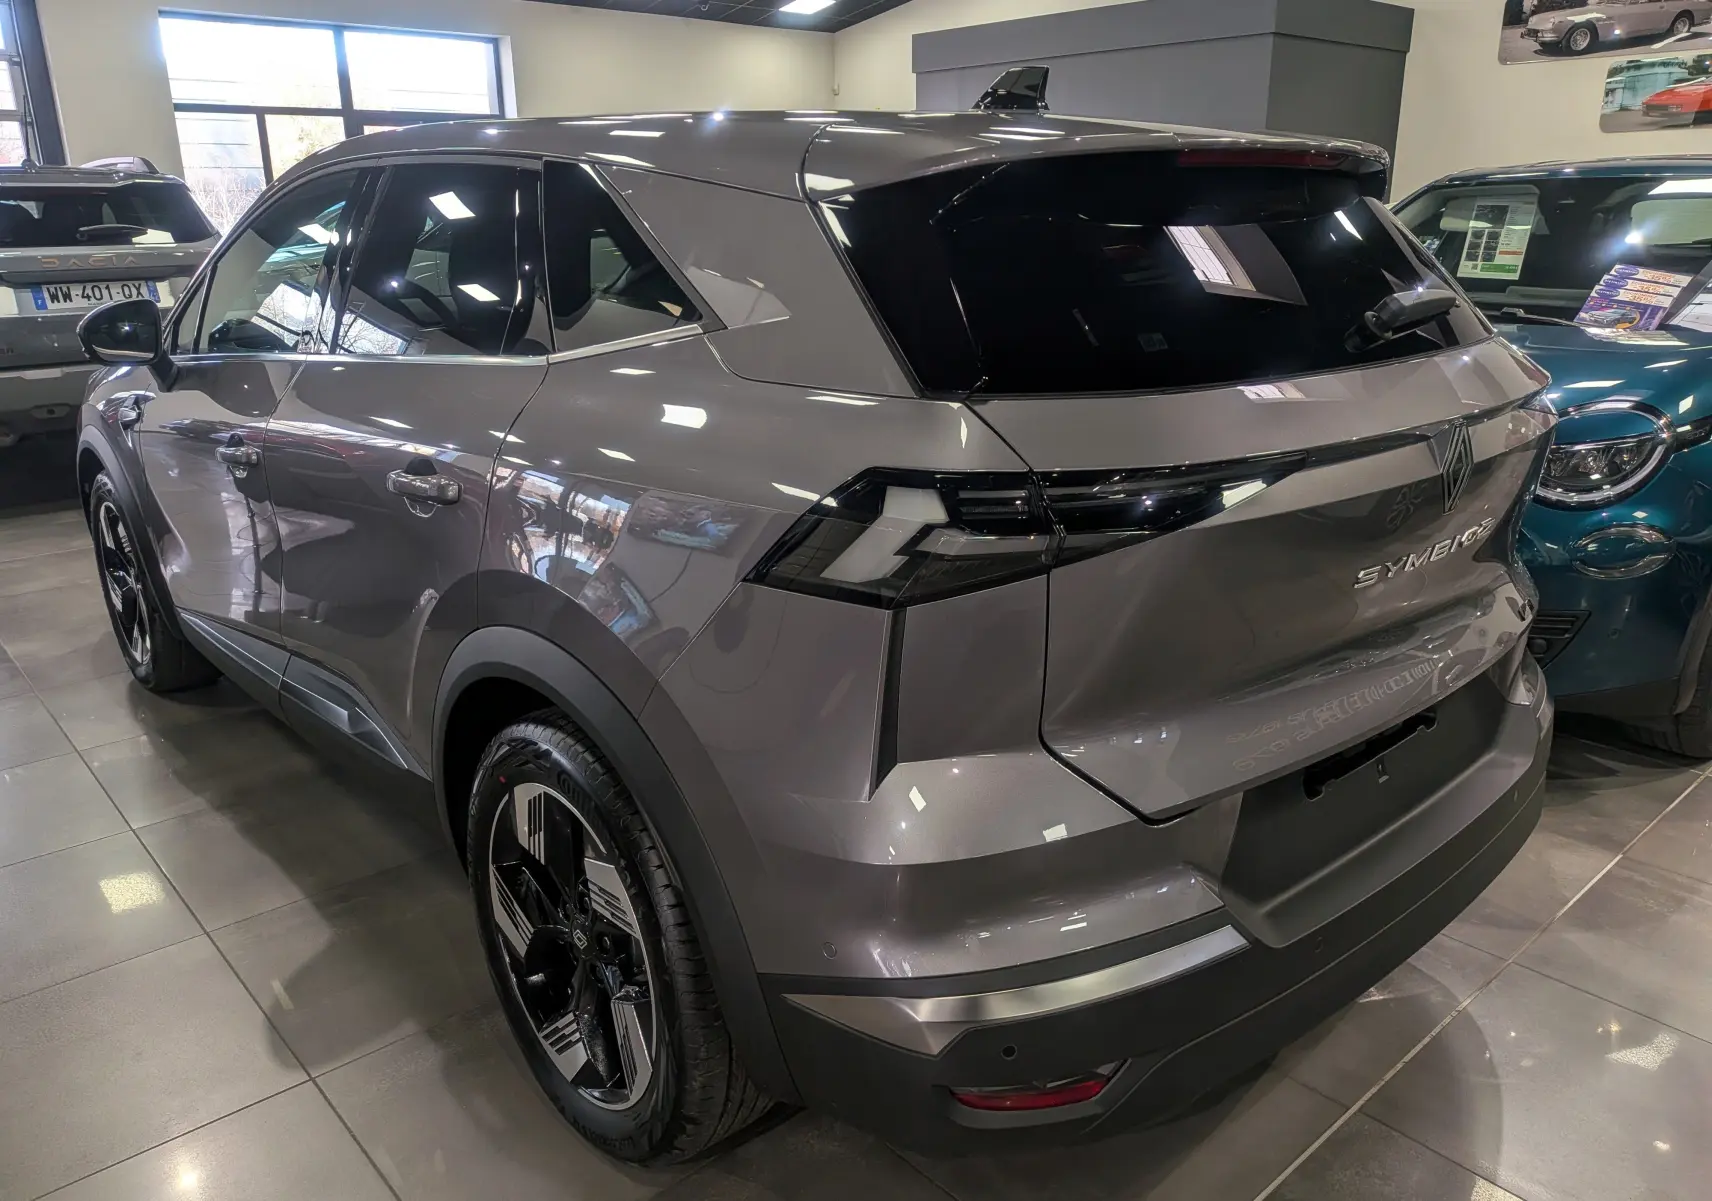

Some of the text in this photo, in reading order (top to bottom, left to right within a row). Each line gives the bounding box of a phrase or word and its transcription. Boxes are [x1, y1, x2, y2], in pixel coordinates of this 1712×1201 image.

[41, 255, 138, 269] DACIA
[46, 283, 145, 304] WW-401-QX
[1353, 517, 1496, 589] SYMBIOZ
